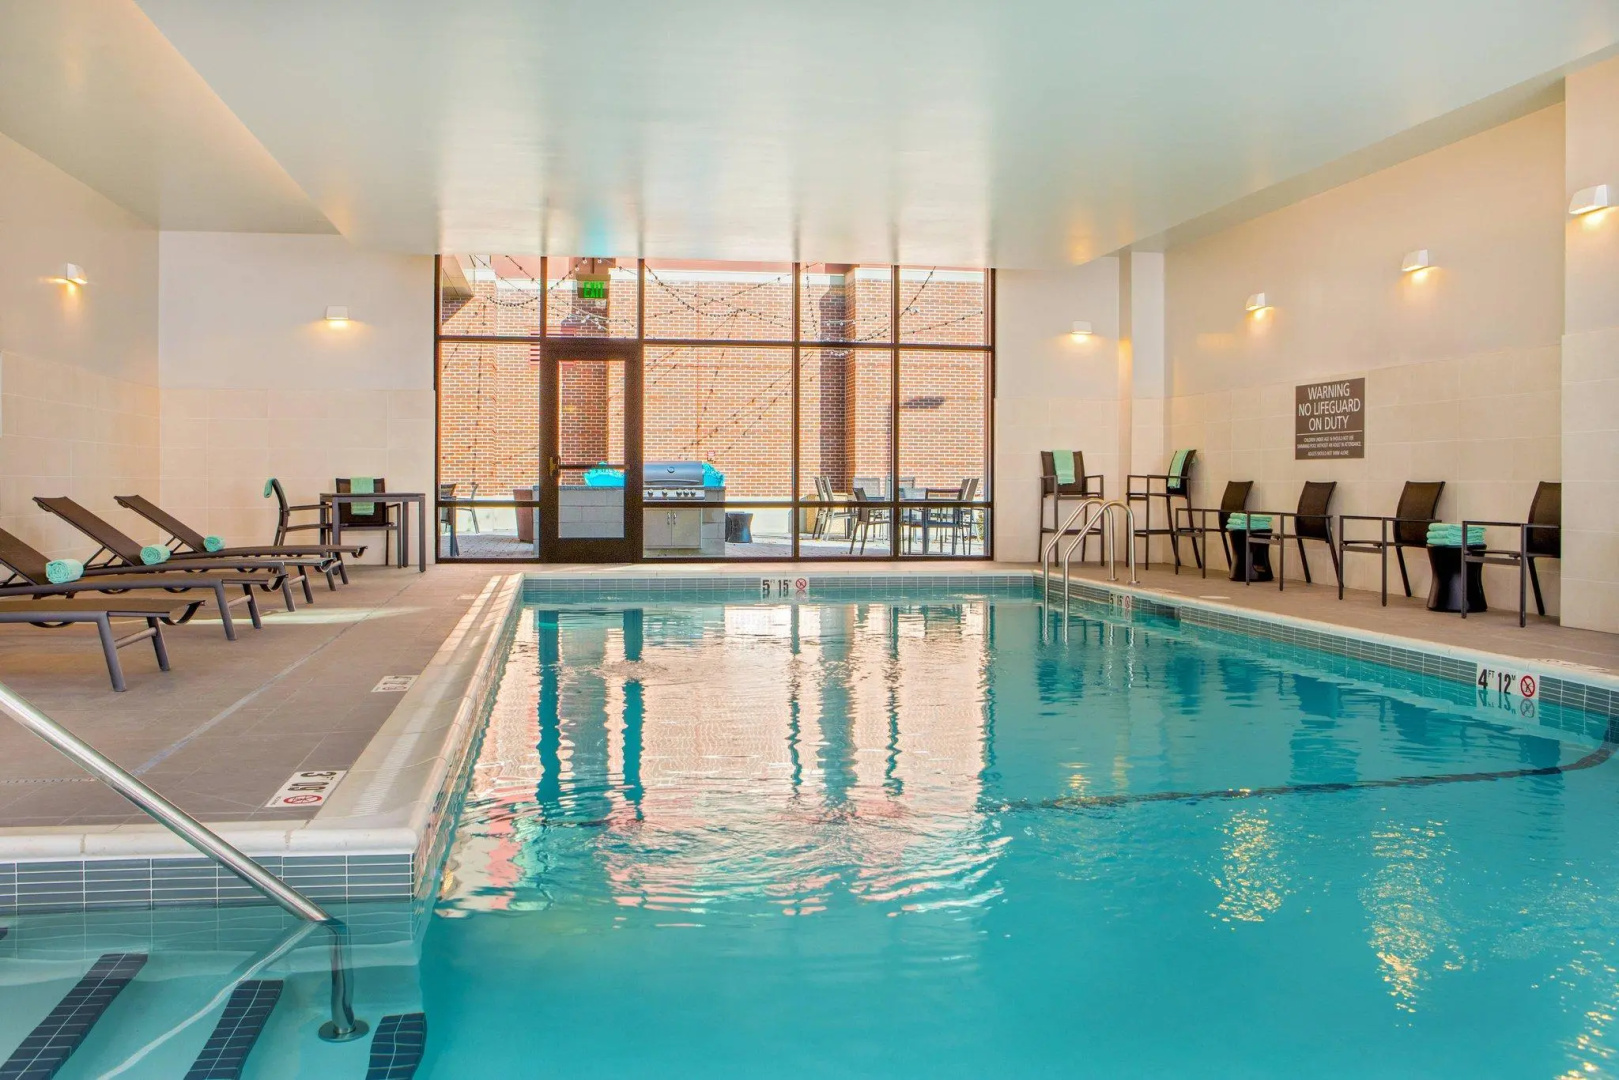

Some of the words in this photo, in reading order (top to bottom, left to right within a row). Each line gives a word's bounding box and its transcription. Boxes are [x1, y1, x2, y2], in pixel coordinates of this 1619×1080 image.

[583, 281, 604, 298] EXIT
[1308, 382, 1350, 401] WARNING
[1298, 402, 1312, 417] NO
[1313, 398, 1361, 416] LIFEGUARD
[1308, 417, 1322, 431] ON
[1324, 415, 1350, 430] DUTY
